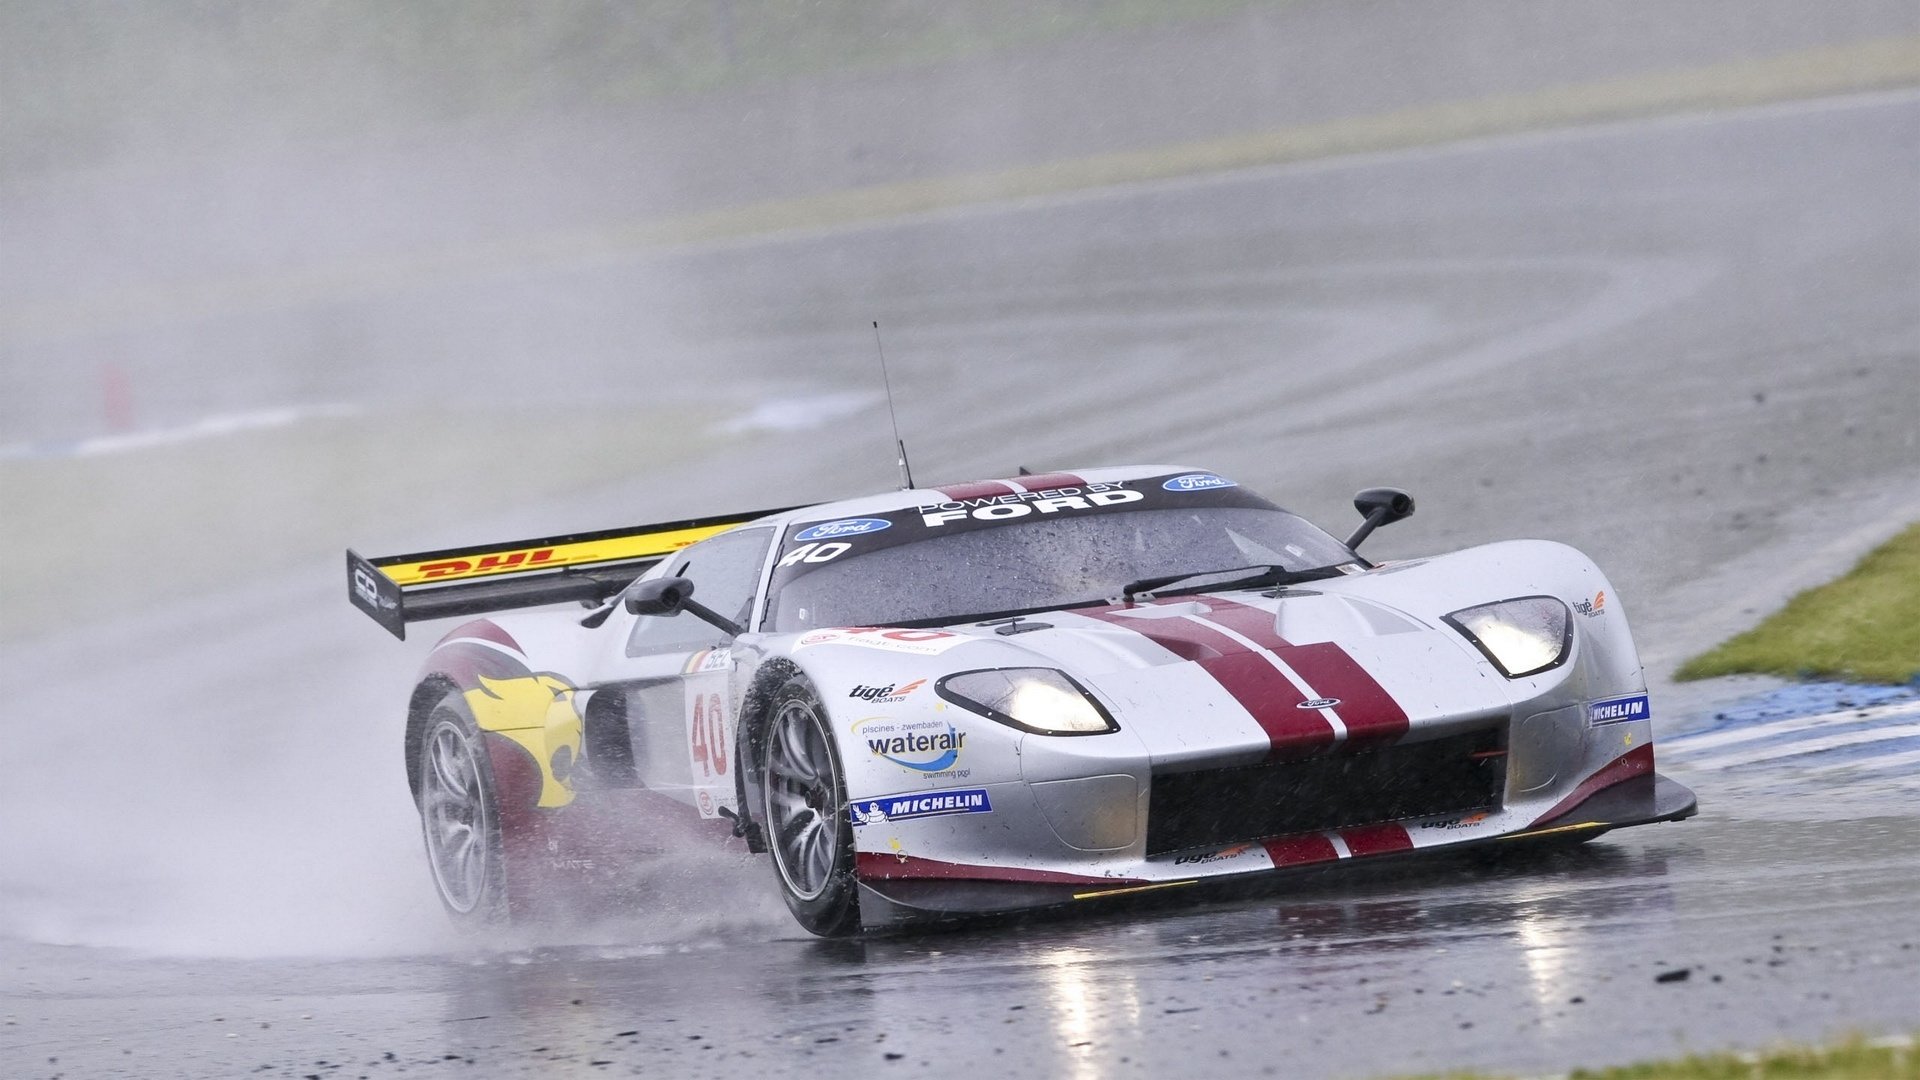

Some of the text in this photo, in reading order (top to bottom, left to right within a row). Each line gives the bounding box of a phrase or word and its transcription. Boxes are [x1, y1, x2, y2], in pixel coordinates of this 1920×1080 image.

[1177, 476, 1225, 489] Ford
[918, 481, 1124, 514] POWERED BY
[922, 490, 1144, 527] FORD
[812, 521, 872, 538] Ford
[418, 549, 567, 578] DHL
[776, 543, 852, 568] 40
[849, 683, 896, 701] tigé
[871, 696, 907, 704] BOATS
[1593, 701, 1644, 719] MICHELIN
[692, 693, 727, 777] 40
[862, 724, 895, 734] piscines
[902, 721, 944, 731] zwembaden
[868, 728, 967, 755] waterair
[923, 768, 971, 780] swimming pool
[891, 795, 983, 815] MICHELIN
